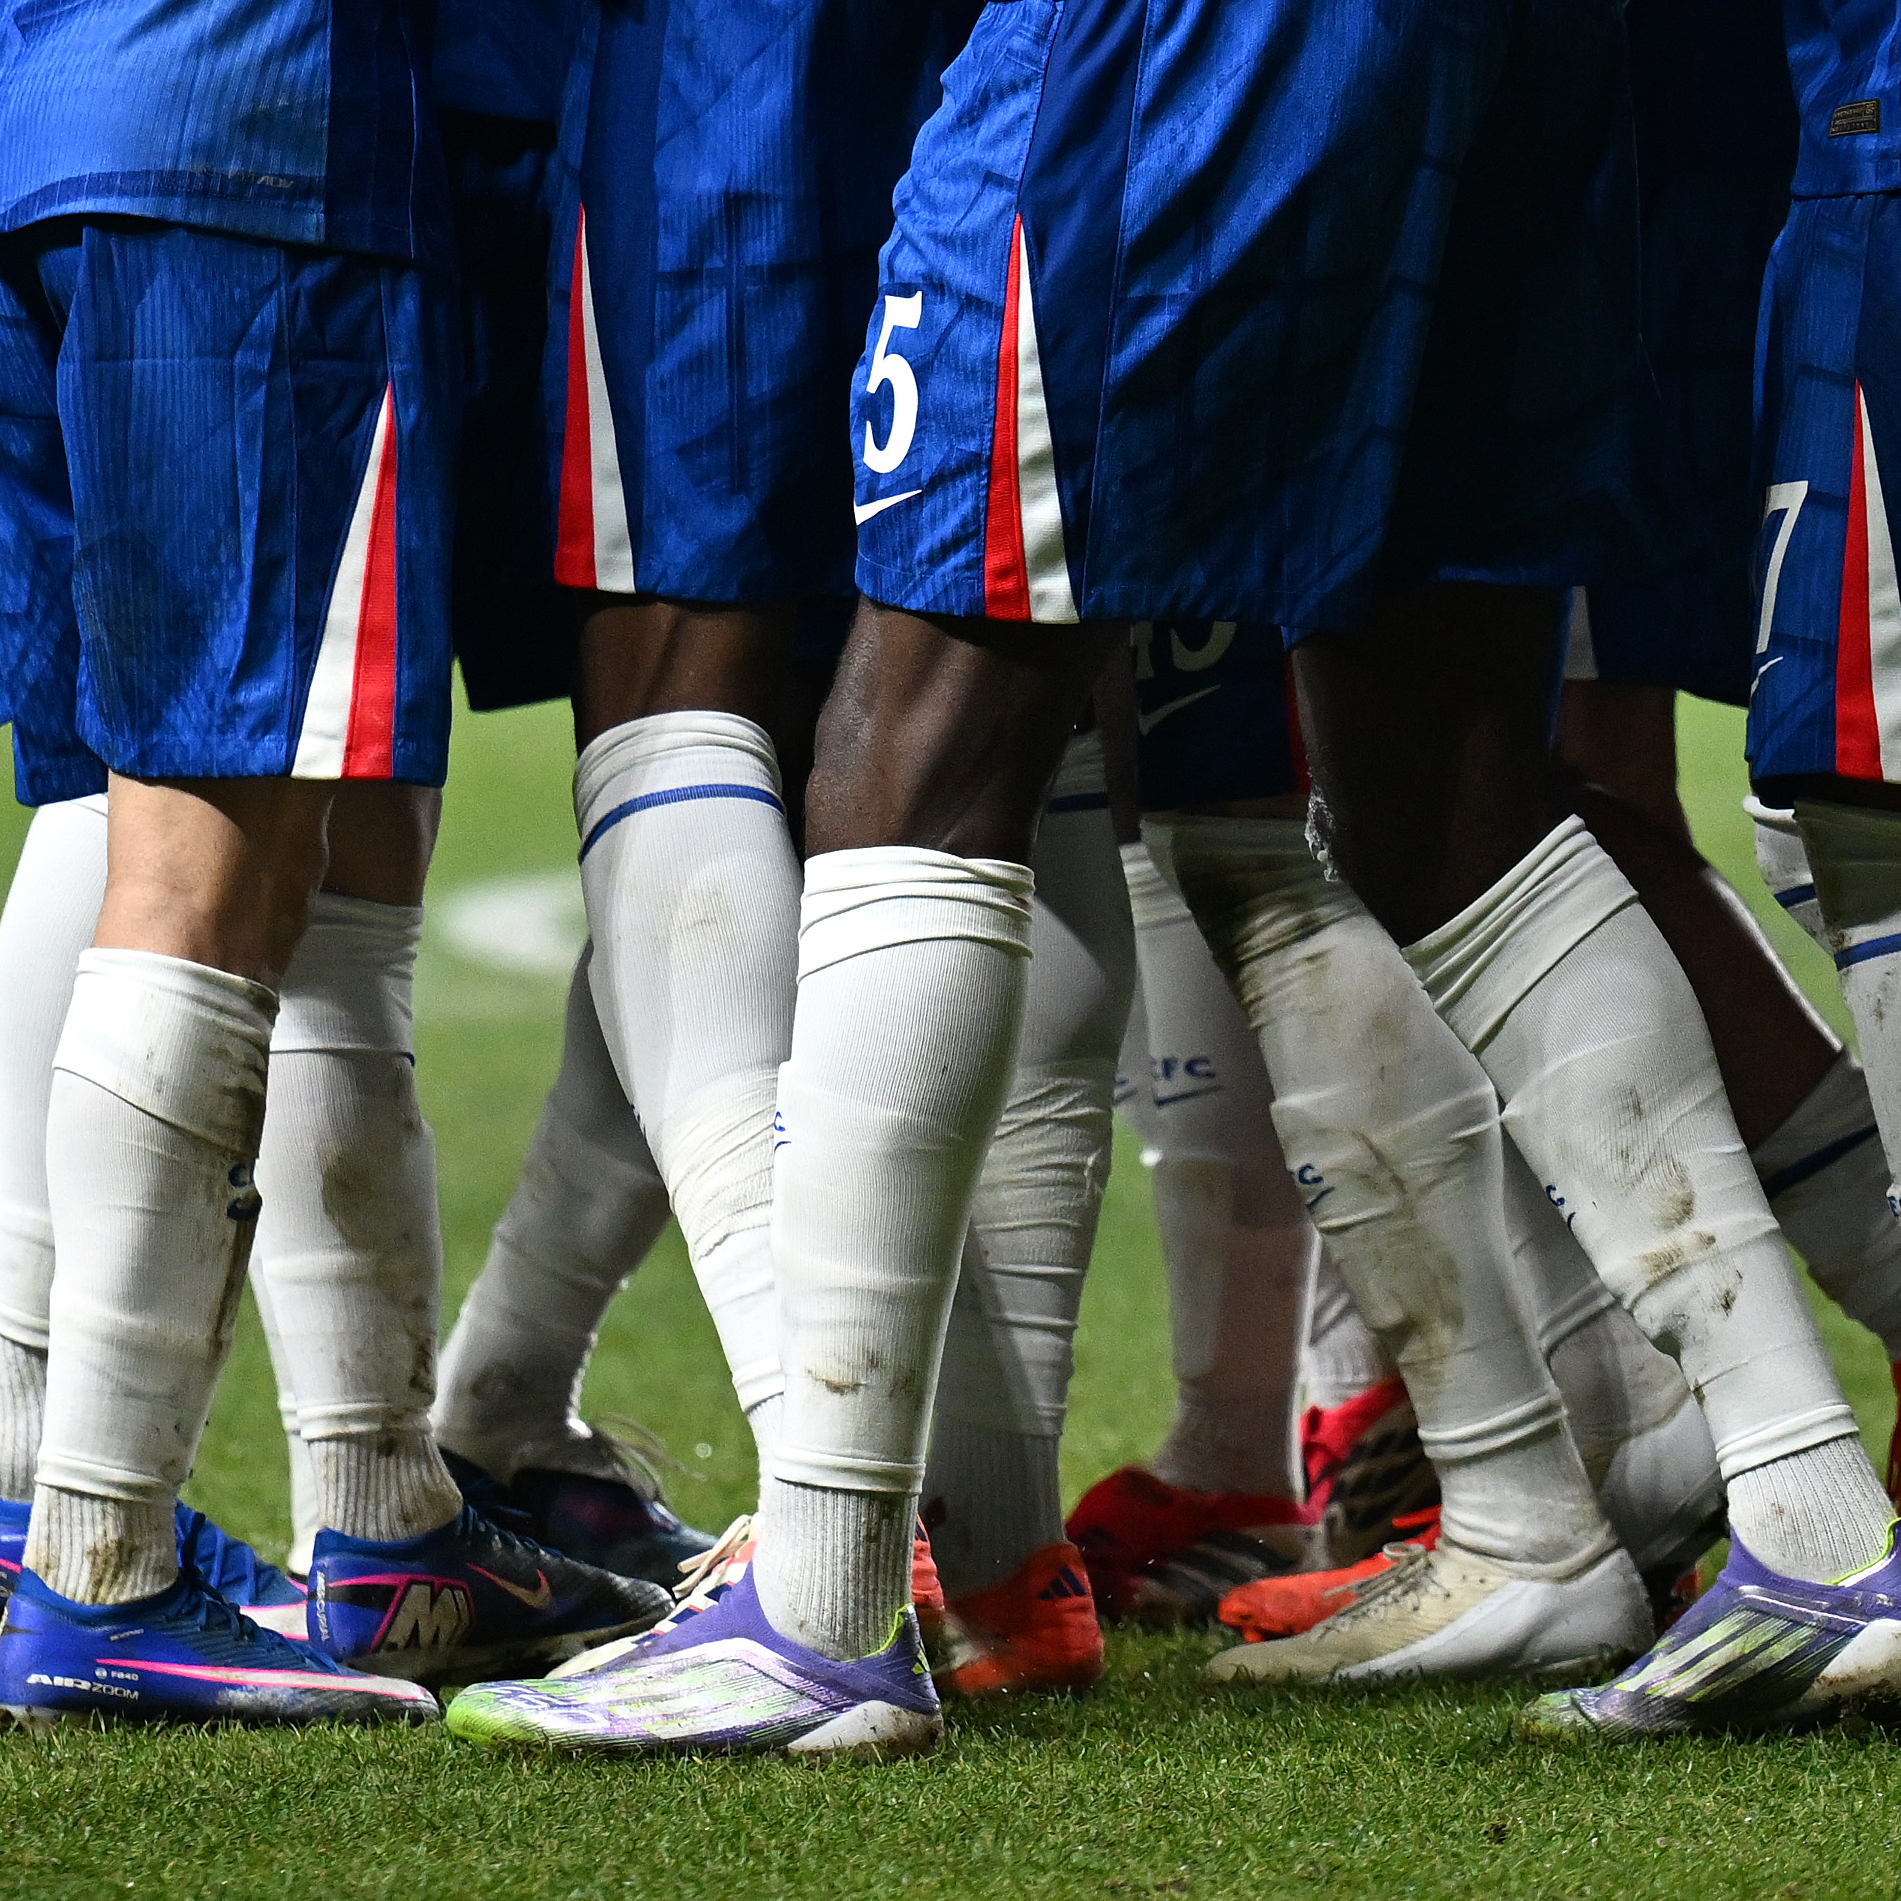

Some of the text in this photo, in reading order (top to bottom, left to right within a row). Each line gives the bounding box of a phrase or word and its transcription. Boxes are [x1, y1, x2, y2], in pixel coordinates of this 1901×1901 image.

[862, 290, 923, 474] 5
[26, 1673, 139, 1700] AIR ZOOM
